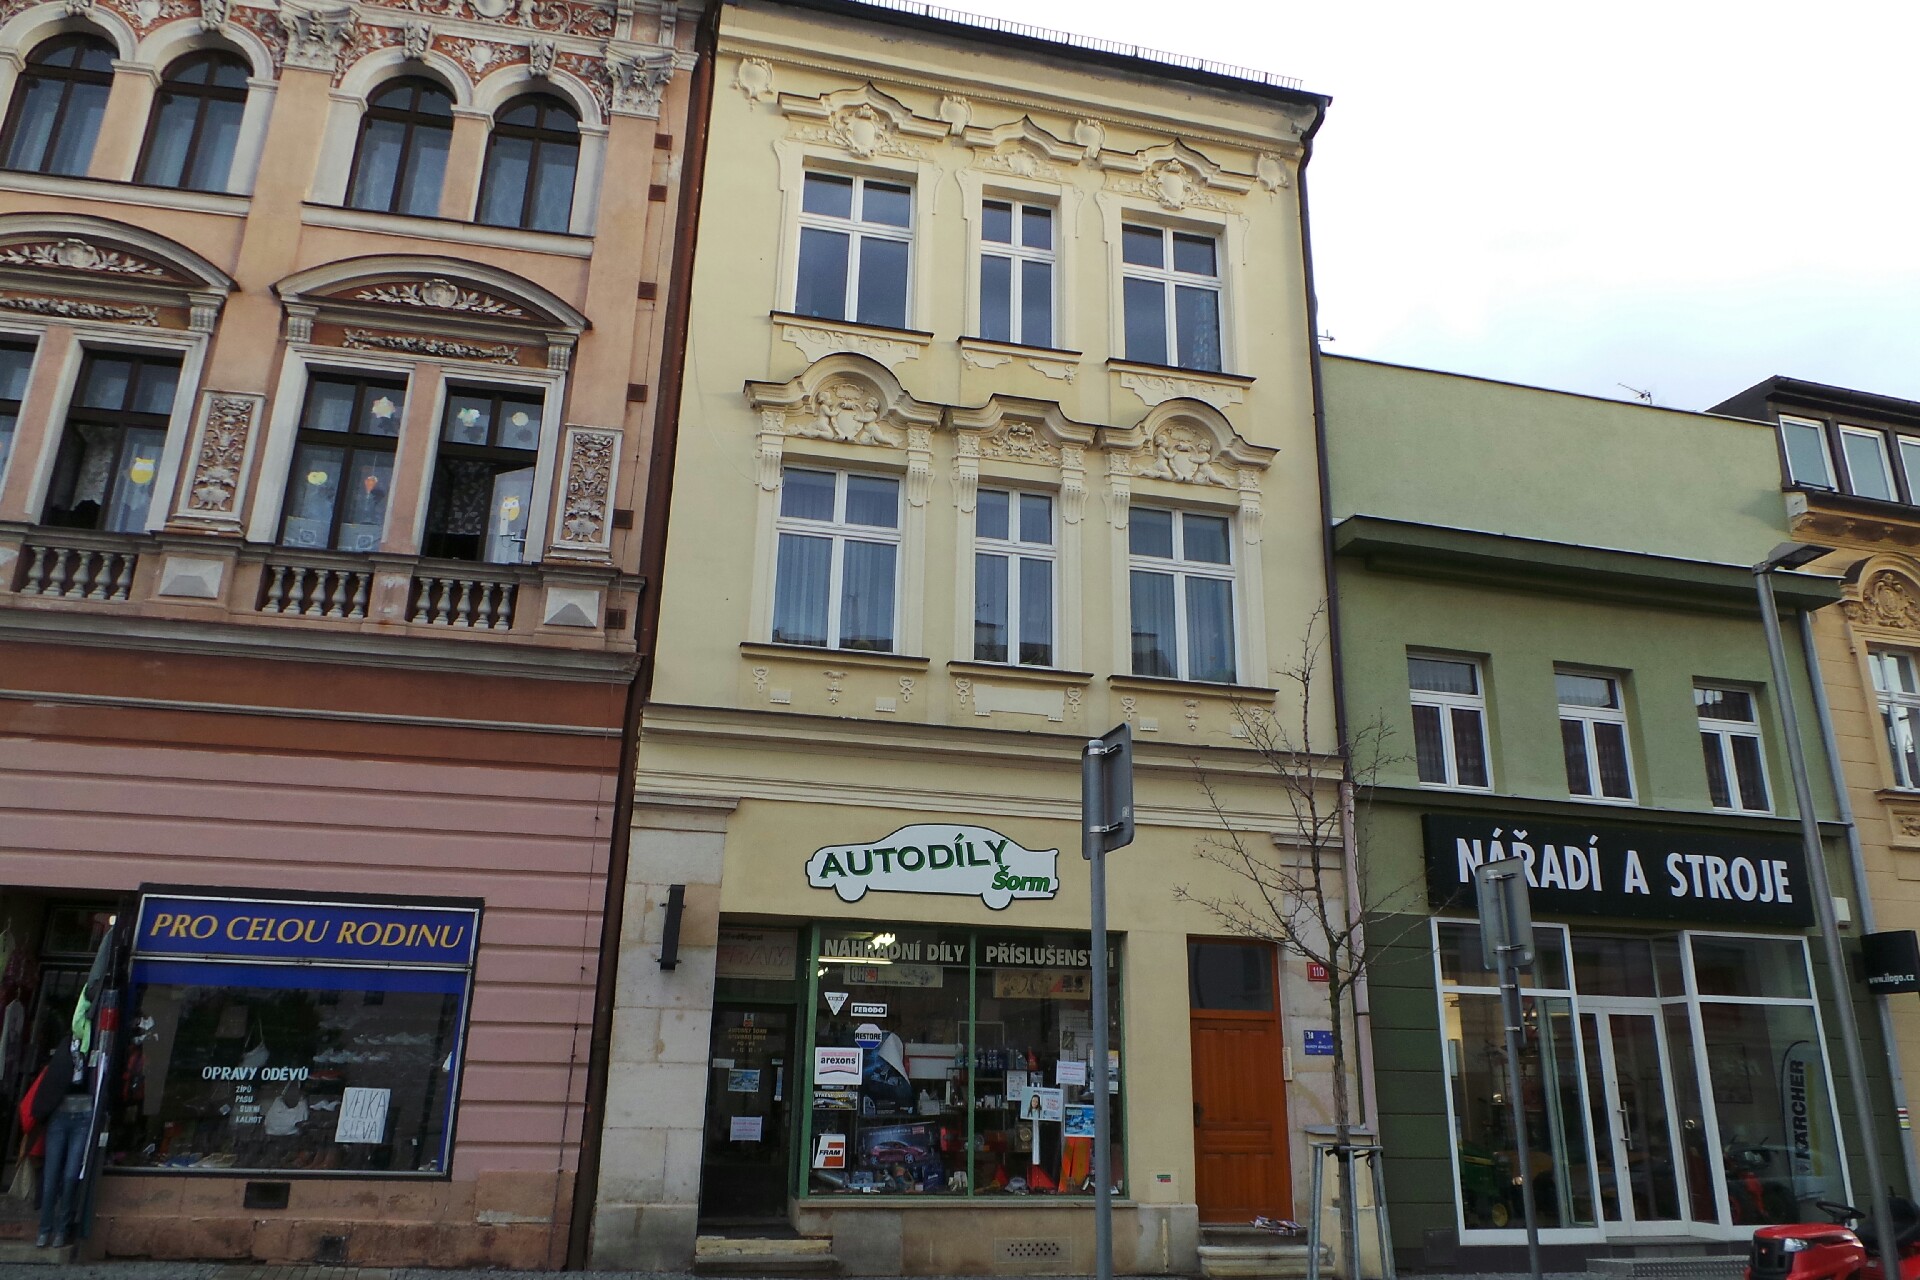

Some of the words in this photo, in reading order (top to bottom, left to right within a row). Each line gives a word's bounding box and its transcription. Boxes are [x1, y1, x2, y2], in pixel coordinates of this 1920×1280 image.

[819, 833, 1009, 878] AUTODÍLY
[991, 865, 1050, 892] Šorm
[1625, 850, 1650, 895] A
[1667, 852, 1793, 903] STROJE
[150, 913, 218, 938] PRO
[226, 916, 330, 943] CELOU
[336, 921, 464, 948] RODINU
[824, 936, 920, 961] NÁHRADNÍ
[927, 941, 965, 962] DÍLY
[985, 943, 1114, 968] PŘÍSLUŠENSÍ
[1312, 967, 1325, 977] 110
[202, 1066, 258, 1080] OPRAVY
[261, 1066, 309, 1081] ODĚVŮ
